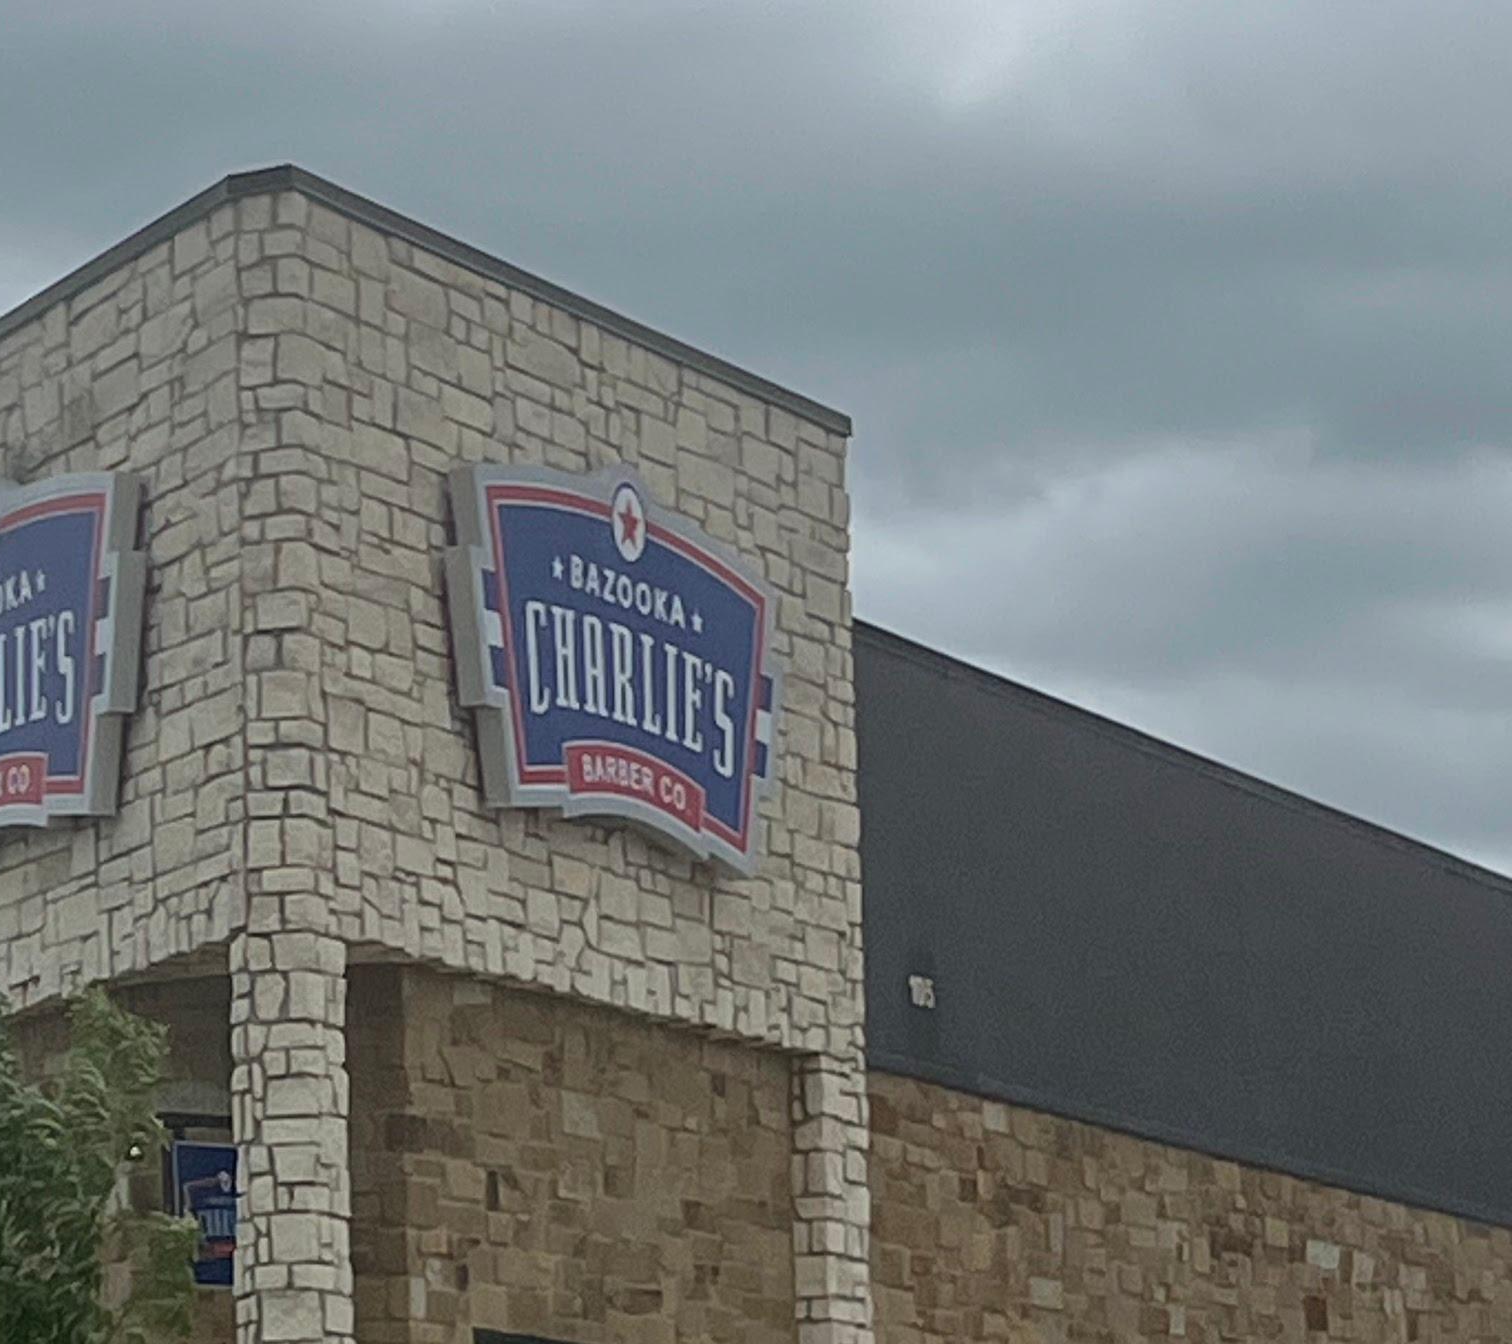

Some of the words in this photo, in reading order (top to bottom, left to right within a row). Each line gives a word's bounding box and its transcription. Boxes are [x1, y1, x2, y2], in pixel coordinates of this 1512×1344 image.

[570, 555, 687, 629] BAZOOKA
[525, 600, 736, 779] CHARLIE'S
[581, 753, 655, 796] BARBER
